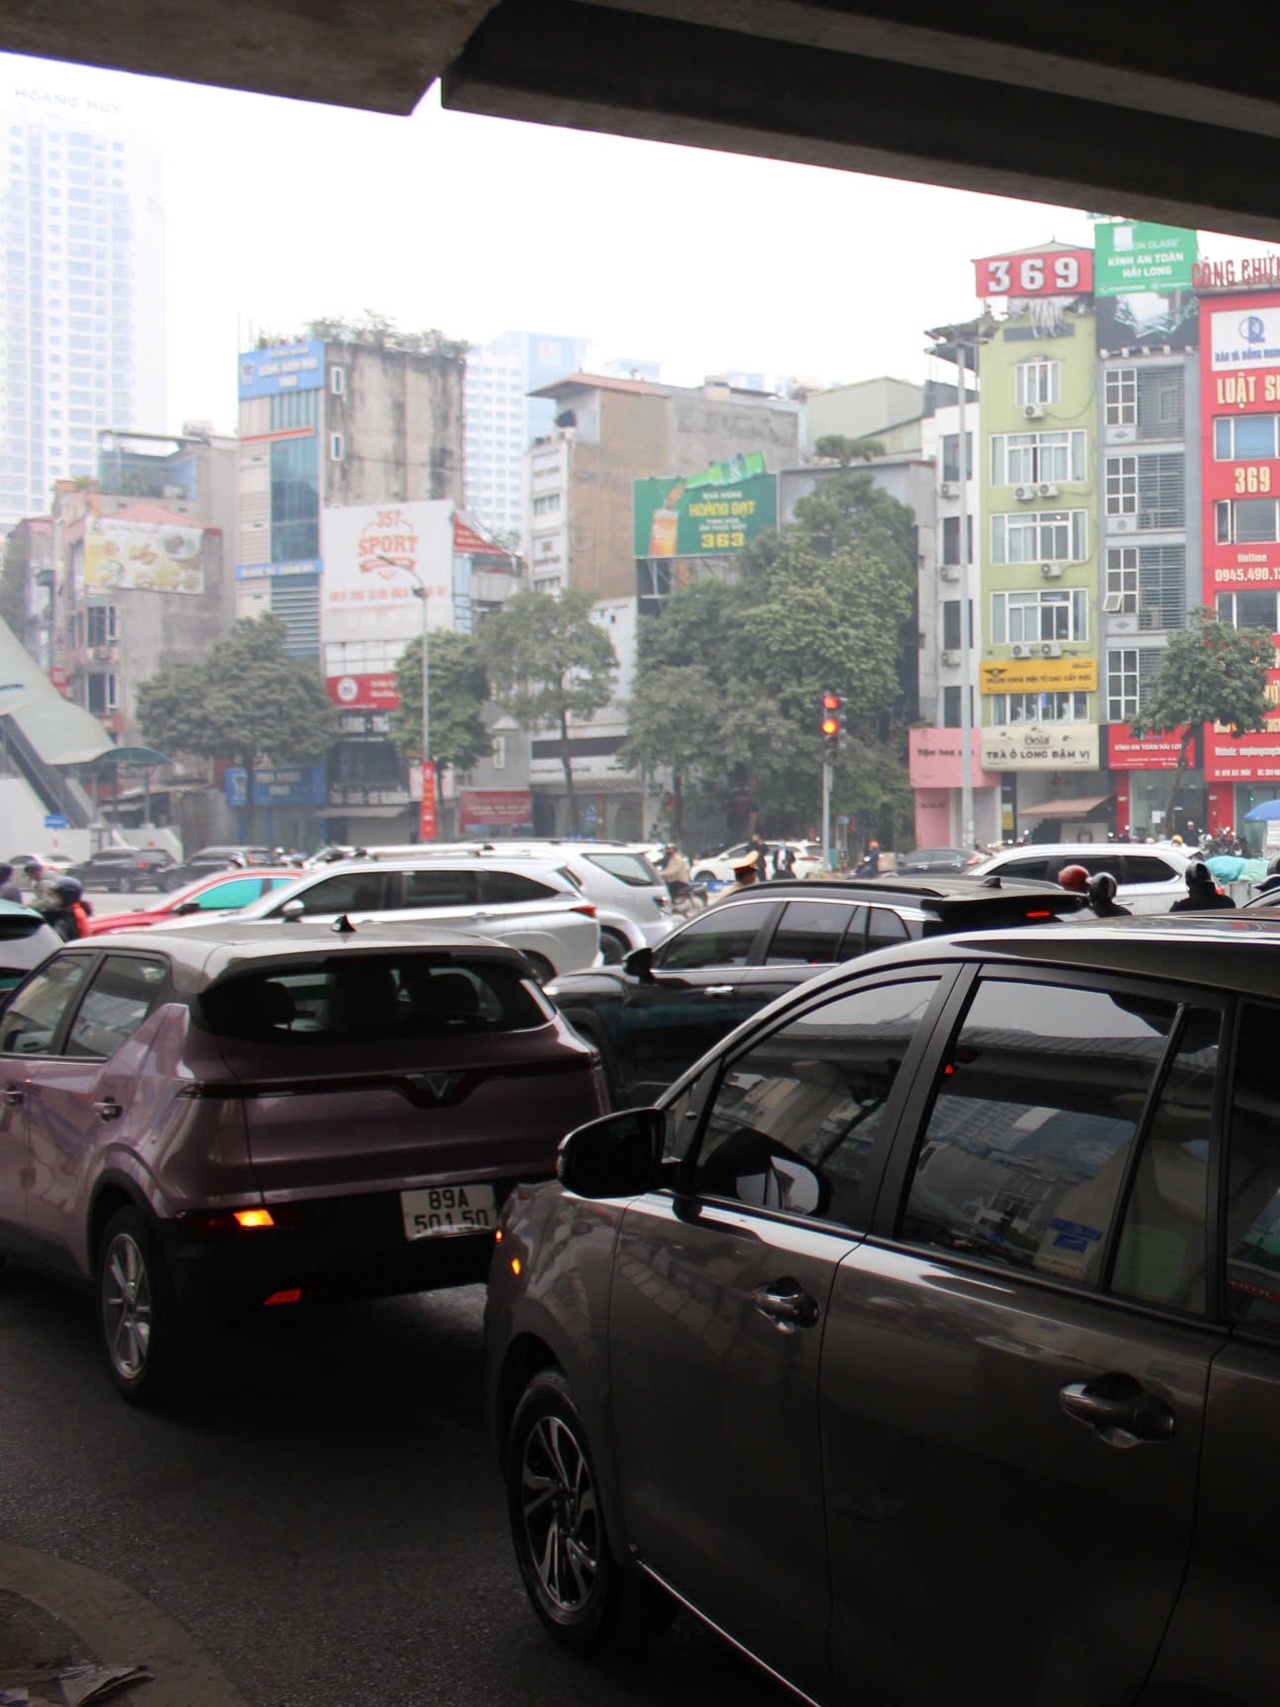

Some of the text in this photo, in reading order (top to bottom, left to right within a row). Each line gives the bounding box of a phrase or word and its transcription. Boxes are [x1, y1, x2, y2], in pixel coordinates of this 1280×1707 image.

[988, 257, 1079, 292] 369
[1217, 372, 1256, 408] LUẬT
[1234, 466, 1271, 493] 369
[358, 535, 419, 557] SPORT
[987, 750, 1007, 759] TRÀ
[1009, 750, 1018, 759] Ô
[1020, 751, 1048, 759] LONG
[1052, 750, 1075, 760] ĐẬM
[428, 1188, 469, 1210] 89A
